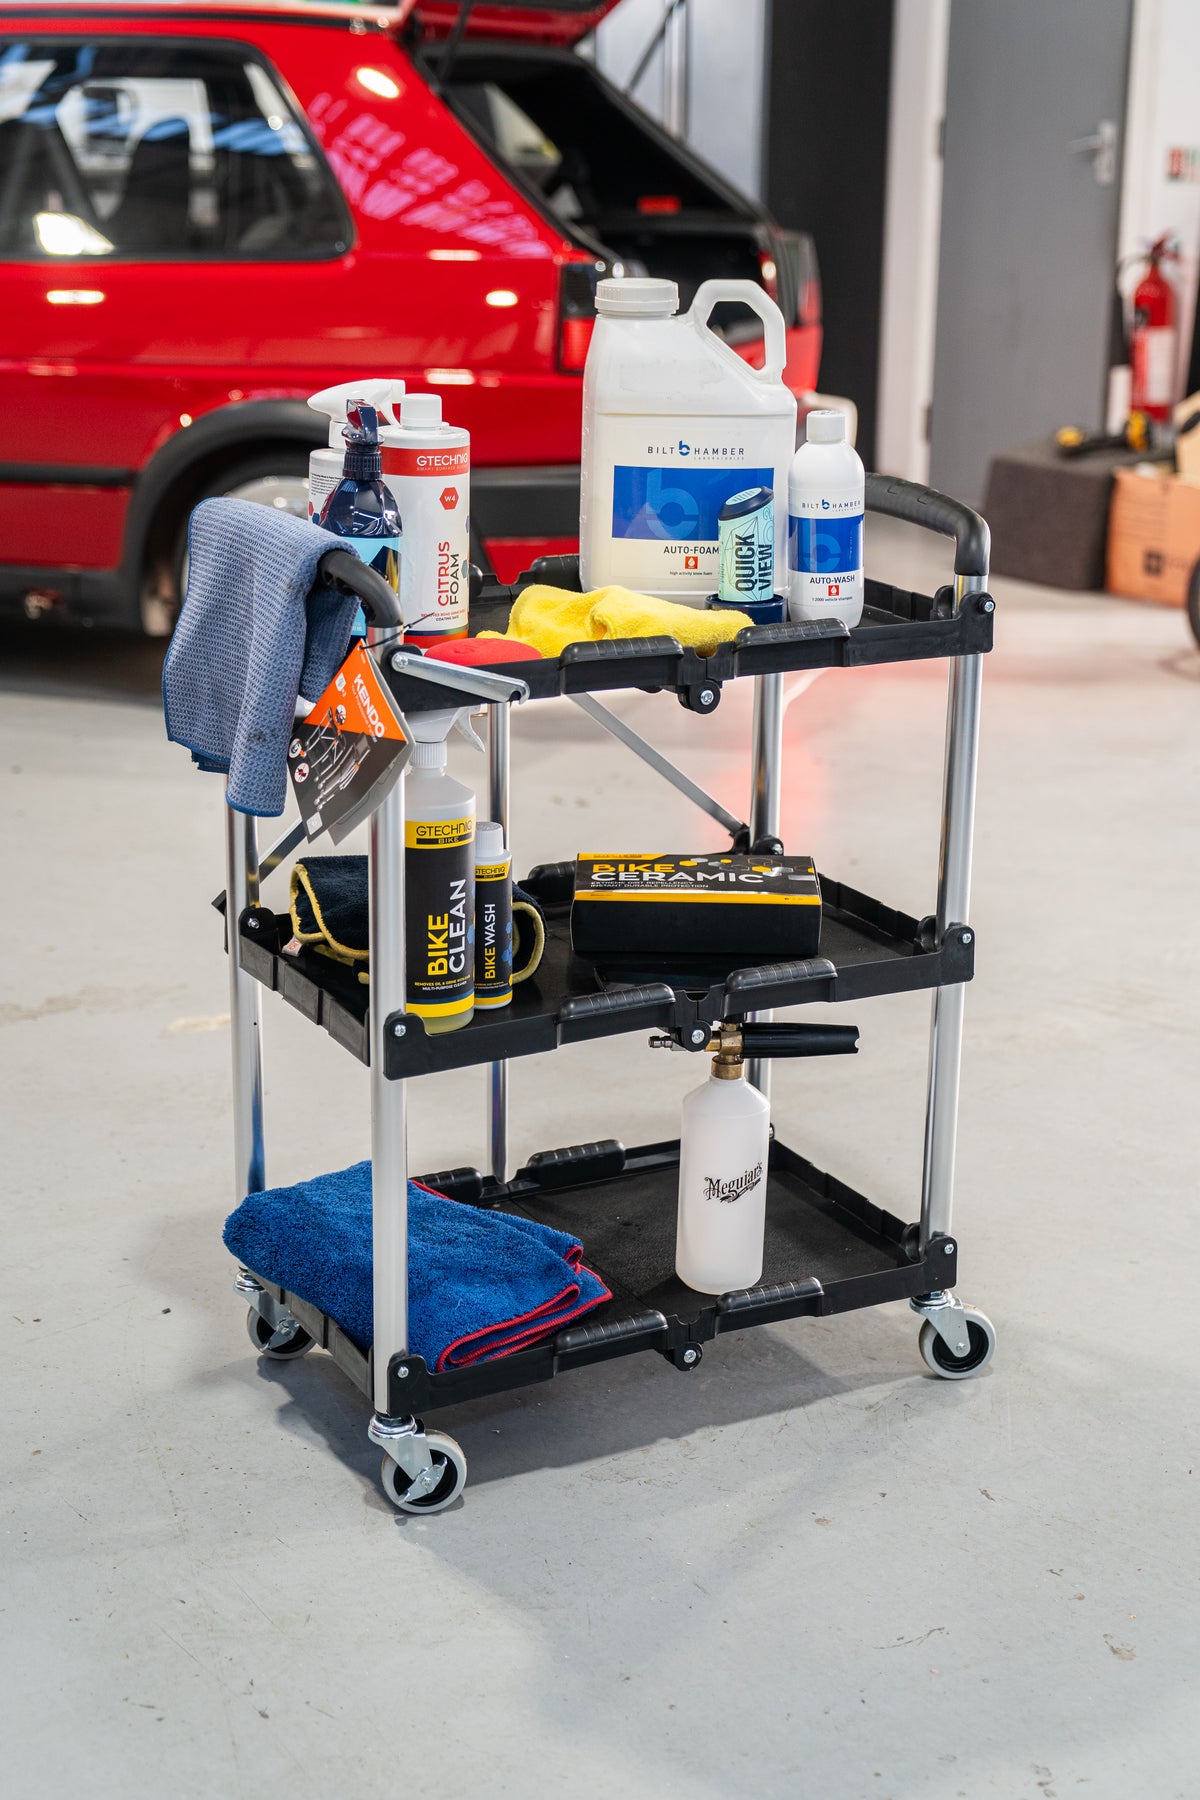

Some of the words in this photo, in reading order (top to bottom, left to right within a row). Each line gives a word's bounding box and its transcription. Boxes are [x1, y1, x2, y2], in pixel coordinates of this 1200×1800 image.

[647, 446, 675, 455] BILT
[694, 447, 745, 456] HAMBER
[663, 545, 720, 555] AUTO-FOAM
[735, 533, 758, 592] QUICK
[758, 543, 773, 591] VIEW
[438, 541, 450, 607] CITRUS
[450, 553, 460, 605] FOAM
[809, 575, 855, 585] AUTO-WASH
[354, 673, 385, 738] KENDO
[416, 819, 473, 837] GTECHNIQ
[438, 836, 460, 844] BIKE
[590, 871, 764, 883] CERAMIC
[592, 863, 676, 873] BIKE
[449, 878, 466, 973] CLEAN
[484, 903, 496, 946] WASH
[427, 913, 449, 976] BIKE
[484, 946, 496, 979] BIKE
